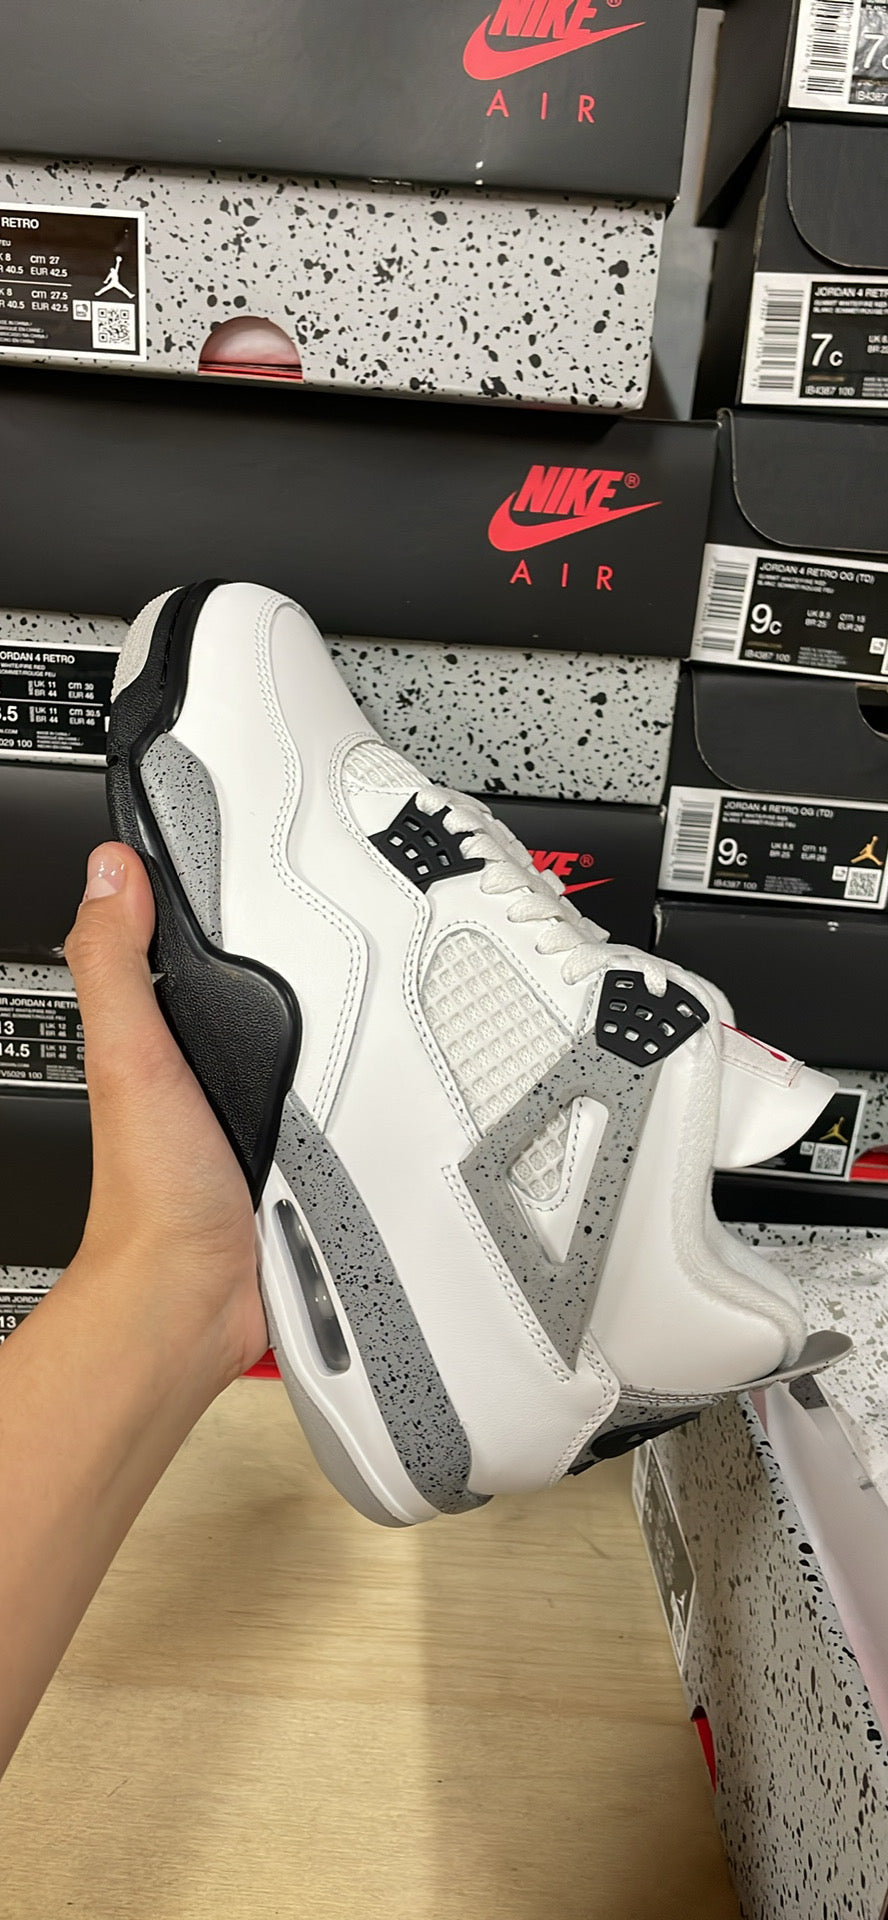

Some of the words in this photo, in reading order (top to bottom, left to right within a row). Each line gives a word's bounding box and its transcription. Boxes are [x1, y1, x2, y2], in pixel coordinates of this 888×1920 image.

[488, 0, 597, 39] NIKE
[486, 89, 595, 124] AIR
[1, 217, 39, 229] RETRO
[5, 253, 11, 261] 8
[30, 255, 46, 264] cm
[49, 256, 60, 264] 27
[5, 266, 24, 275] 40.5
[30, 266, 48, 276] EUR
[49, 269, 68, 278] 42.5
[6, 288, 13, 296] 8
[31, 290, 47, 299] cm
[51, 291, 68, 300] 27.5
[815, 287, 856, 297] JORDAN
[856, 289, 863, 297] 4
[7, 300, 25, 310] 40.5
[31, 302, 49, 312] EUR
[51, 303, 69, 313] 42.5
[512, 465, 625, 517] NIKE
[509, 559, 613, 591] AIR
[759, 562, 798, 575] JORDAN
[798, 567, 805, 575] 4
[806, 567, 838, 579] RETRO
[855, 573, 875, 584] (TD)
[34, 653, 41, 662] 4
[43, 653, 75, 664] RETRO
[775, 652, 791, 662] 100
[34, 680, 45, 688] UK
[48, 681, 56, 689] 11
[68, 682, 82, 690] cm
[34, 689, 45, 697] BR
[48, 690, 57, 698] 44
[68, 691, 84, 700] EUR
[35, 706, 46, 714] UK
[49, 707, 57, 715] 11
[69, 708, 83, 716] cm
[35, 715, 47, 723] BR
[49, 716, 58, 724] 44
[69, 717, 85, 725] EUR
[17, 739, 33, 748] 100
[724, 801, 760, 812] JORDAN
[761, 804, 767, 812] 4
[768, 804, 799, 815] RETRO
[800, 807, 815, 817] OG
[816, 808, 834, 819] (TD)
[528, 850, 579, 877] KE
[743, 881, 758, 890] 100
[9, 998, 45, 1008] JORDAN
[47, 1000, 52, 1008] 4
[54, 1001, 78, 1009] RETR
[0, 1043, 30, 1057] 14.5
[28, 1072, 43, 1080] 100
[12, 1296, 42, 1304] JORDA
[0, 1315, 17, 1329] 13
